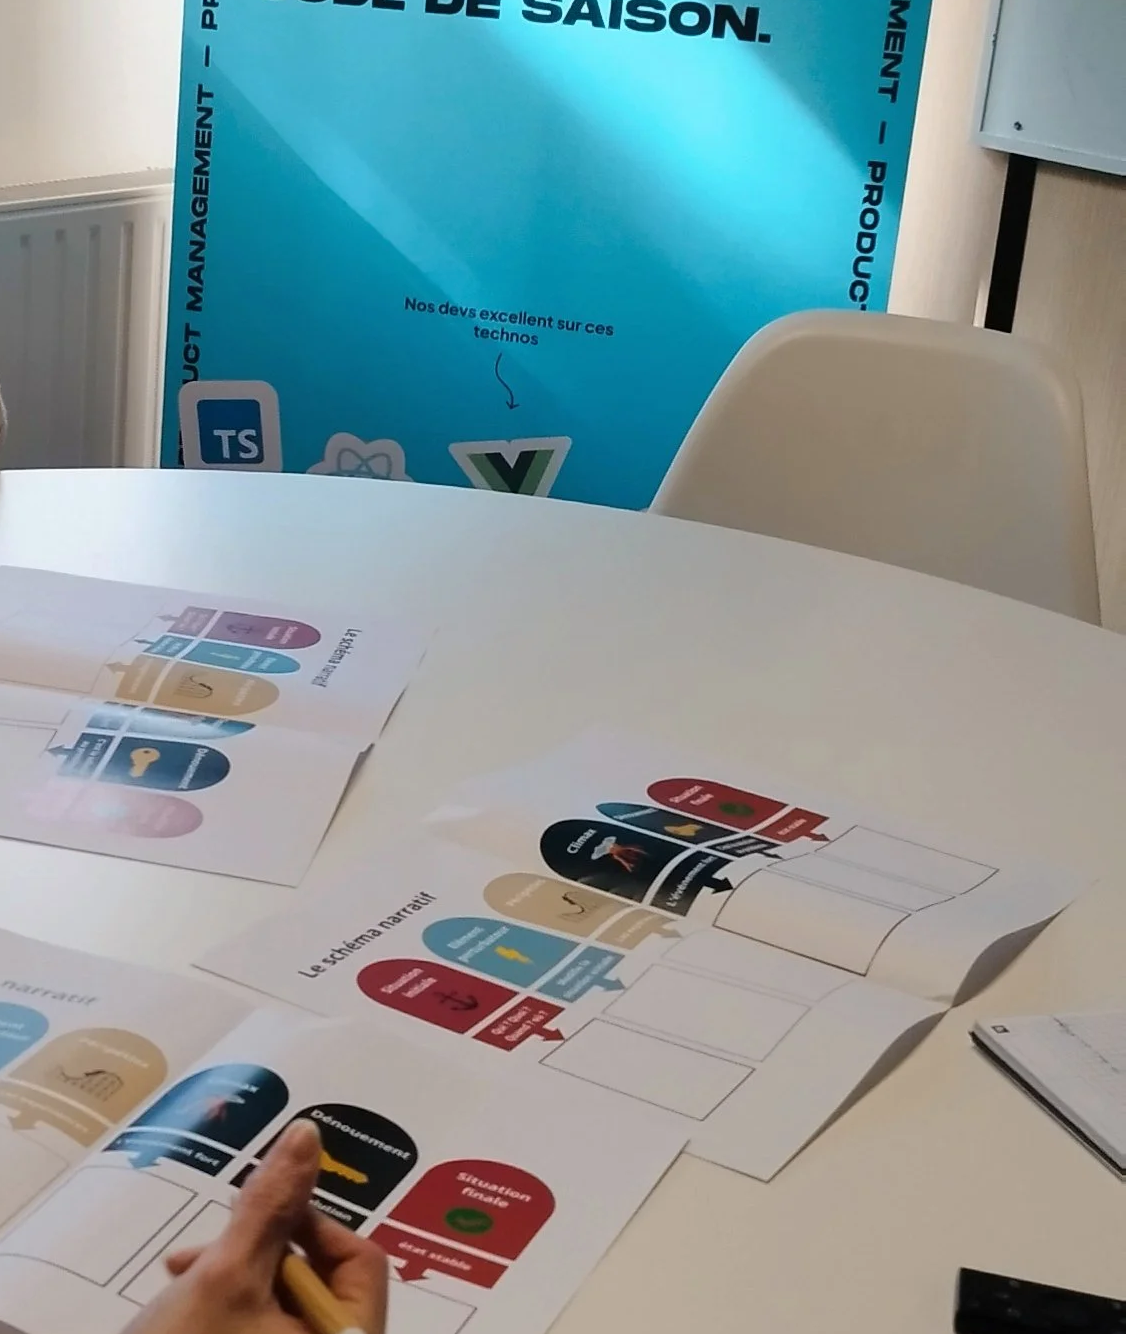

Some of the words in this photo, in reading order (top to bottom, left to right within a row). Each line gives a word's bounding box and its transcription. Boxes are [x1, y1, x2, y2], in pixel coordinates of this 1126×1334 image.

[186, 84, 213, 312] MANAGEMENT
[405, 297, 435, 313] Nos
[439, 301, 476, 318] devs
[480, 310, 553, 329] excellent
[558, 320, 582, 331] sur
[585, 323, 613, 336] ces
[474, 324, 538, 345] technos
[213, 429, 259, 460] TS
[566, 828, 598, 854] Climax
[298, 961, 324, 979] Le
[322, 928, 382, 967] schéma
[380, 891, 437, 930] narratif
[0, 979, 99, 1006] narratif
[311, 1109, 412, 1160] Dénouement
[456, 1171, 533, 1203] Situation
[461, 1187, 509, 1209] finale
